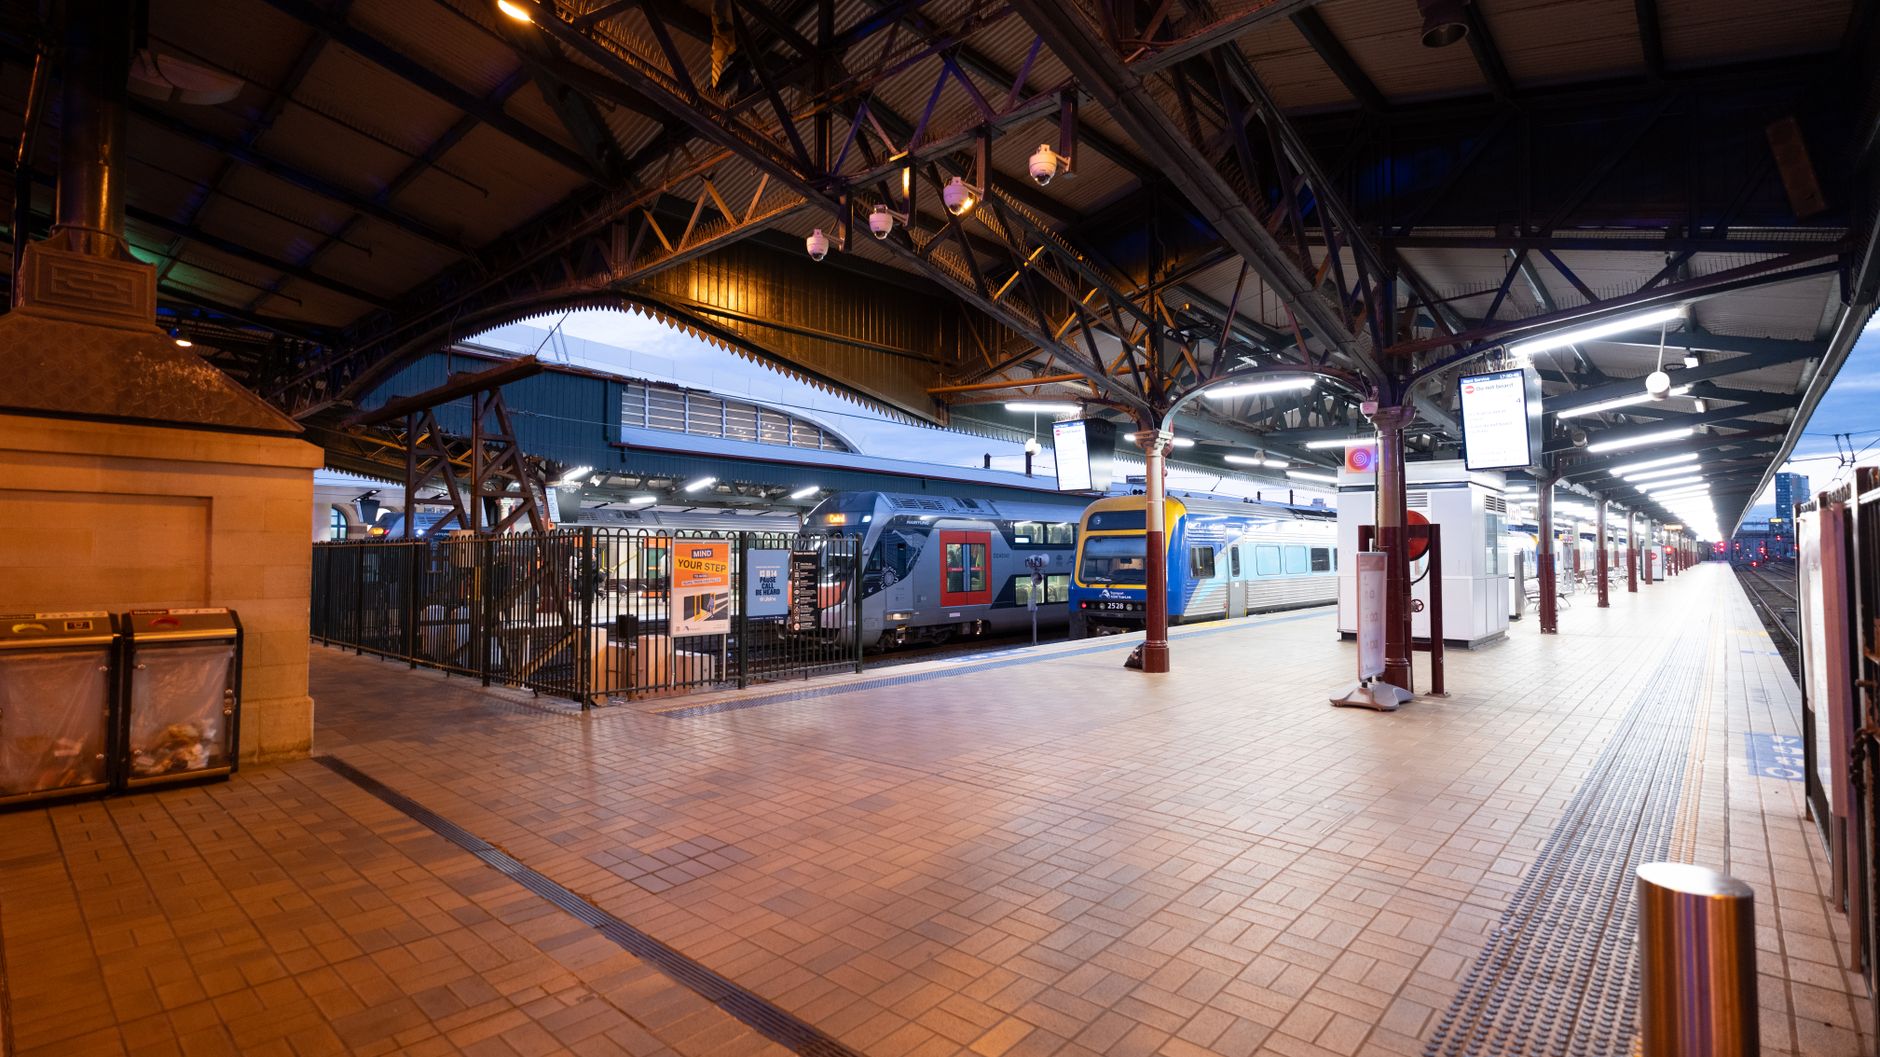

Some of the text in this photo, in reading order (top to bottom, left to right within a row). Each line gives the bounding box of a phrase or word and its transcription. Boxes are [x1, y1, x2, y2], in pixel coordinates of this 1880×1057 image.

[693, 550, 712, 558] MIND
[678, 559, 727, 572] YOUR STEP
